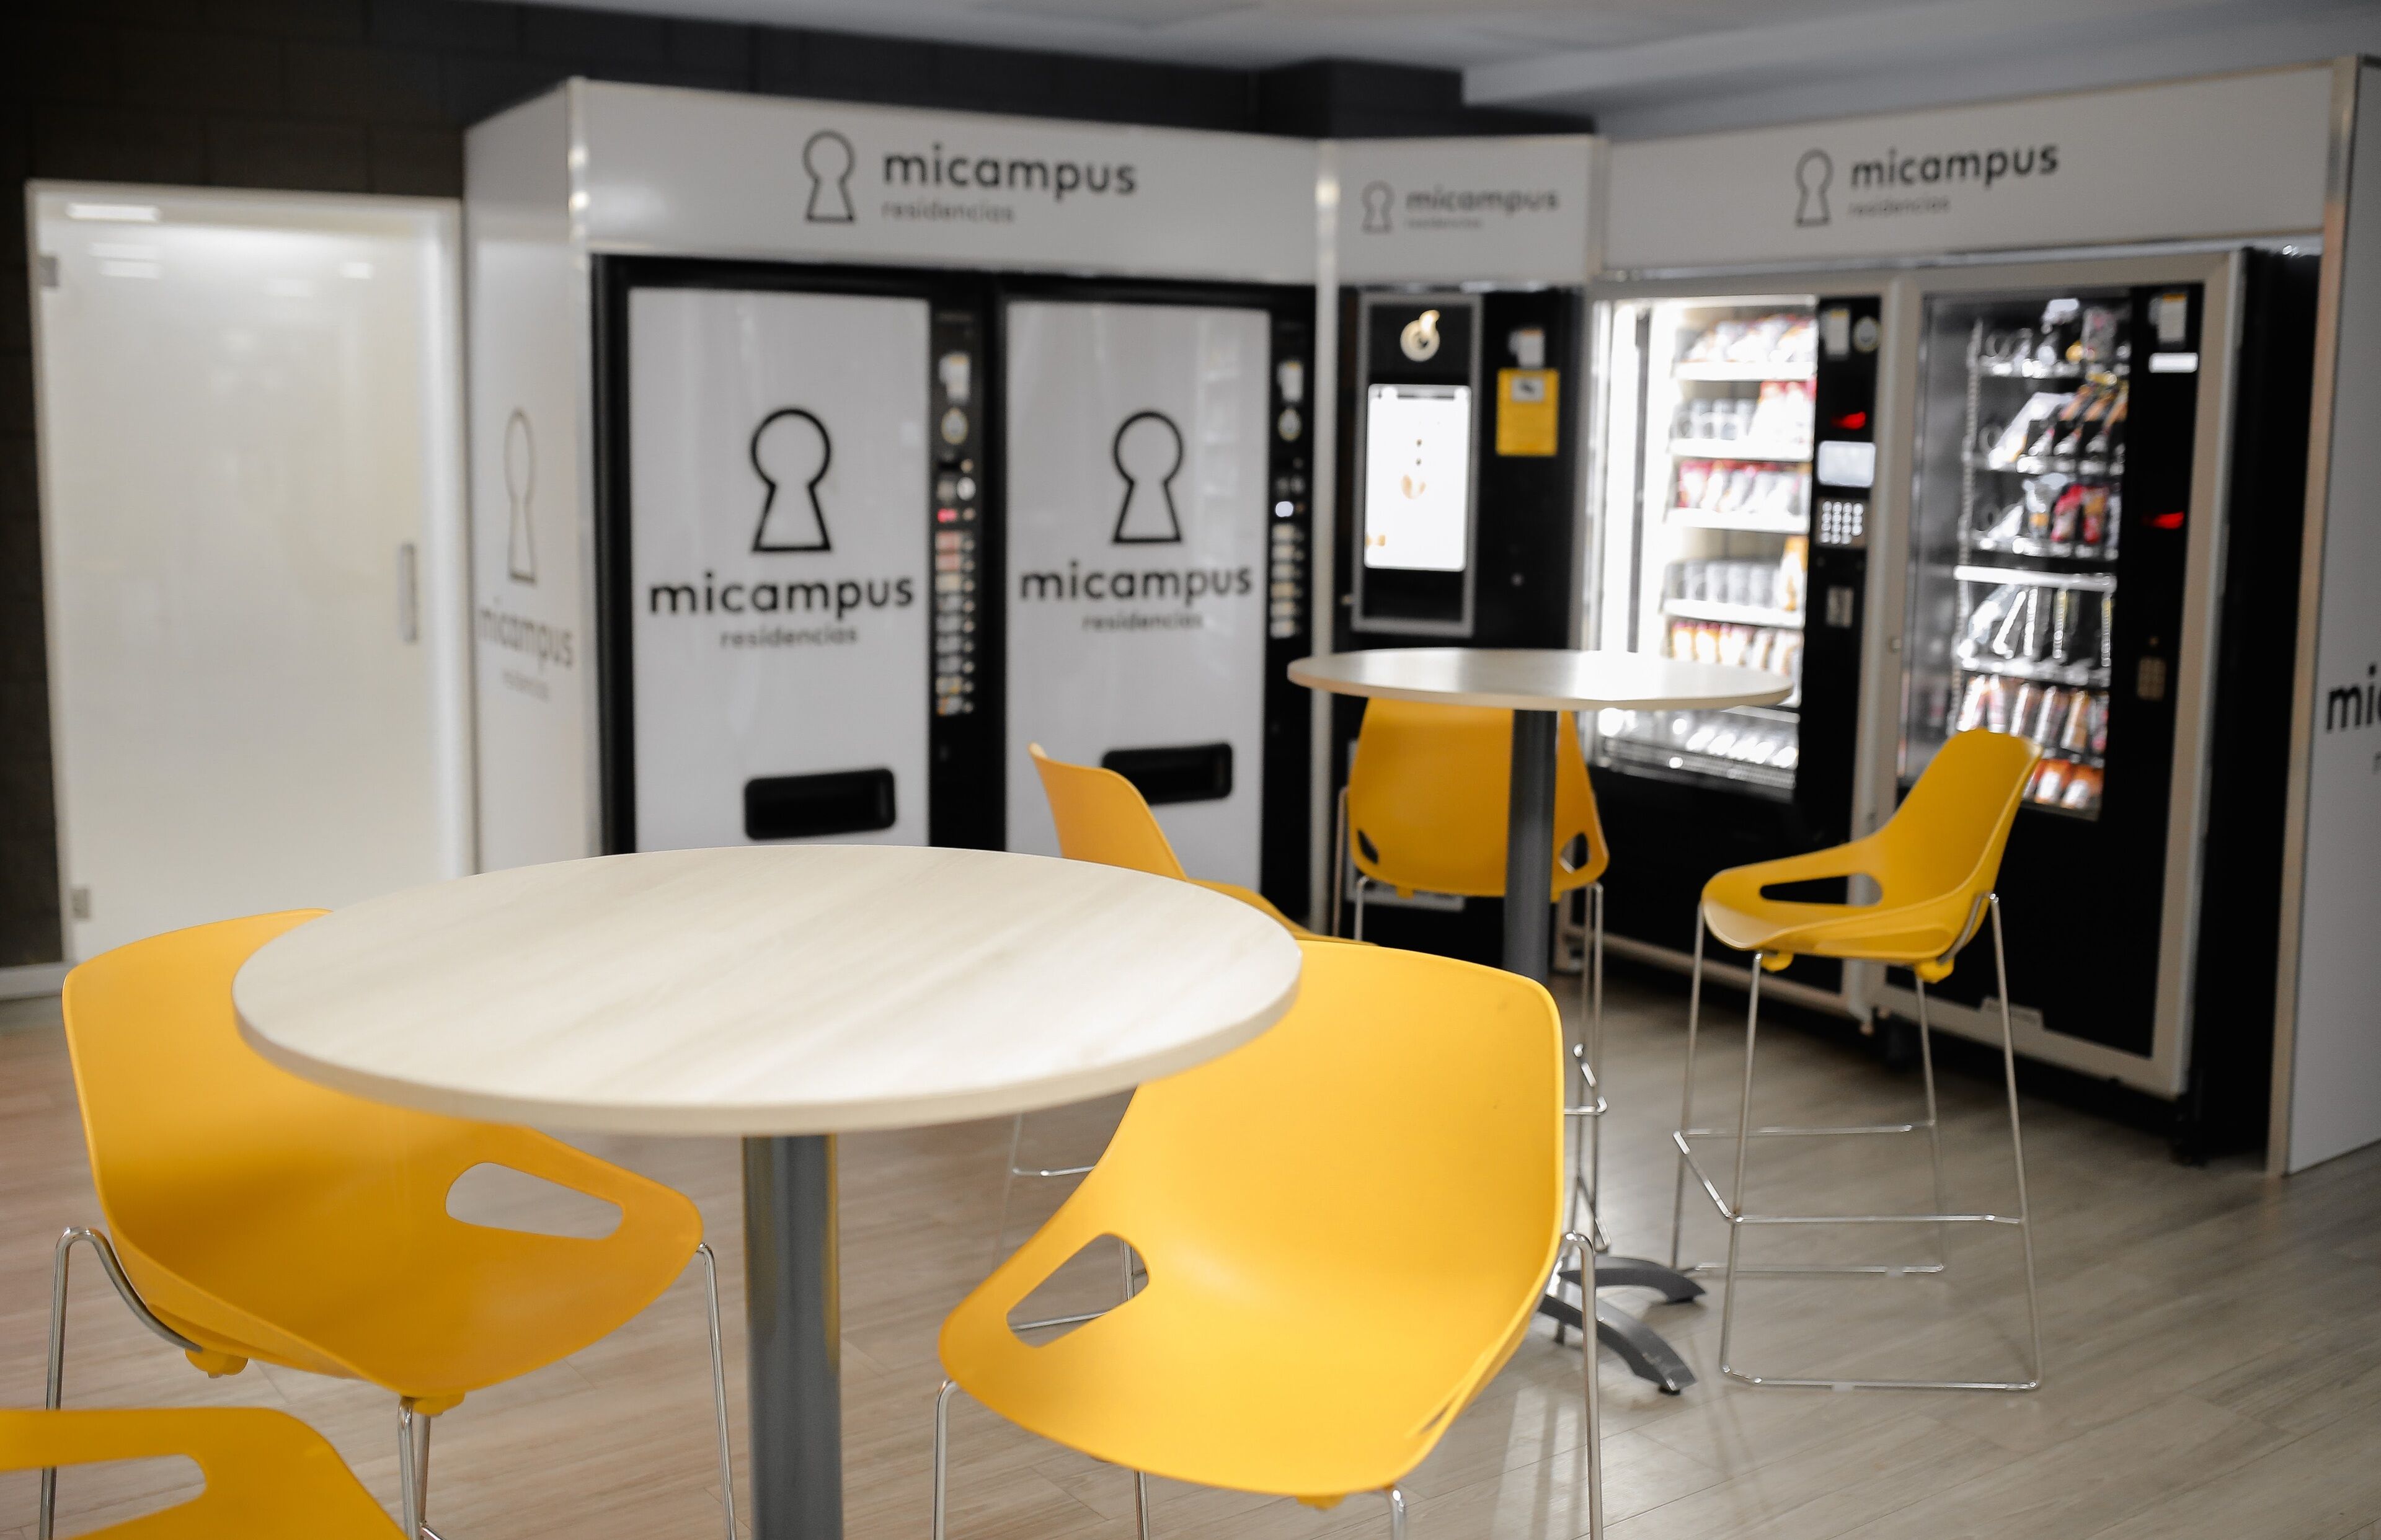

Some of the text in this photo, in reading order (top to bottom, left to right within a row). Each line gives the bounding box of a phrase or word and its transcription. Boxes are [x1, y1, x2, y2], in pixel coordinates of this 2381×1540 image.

[883, 142, 1137, 202] micampus
[1850, 144, 2059, 189] micampus
[882, 200, 1014, 223] residencias
[1405, 185, 1559, 217] micampus
[650, 569, 914, 620] micampus
[1019, 560, 1253, 606] micampus
[719, 624, 858, 647] residencias
[2326, 662, 2381, 734] mi
